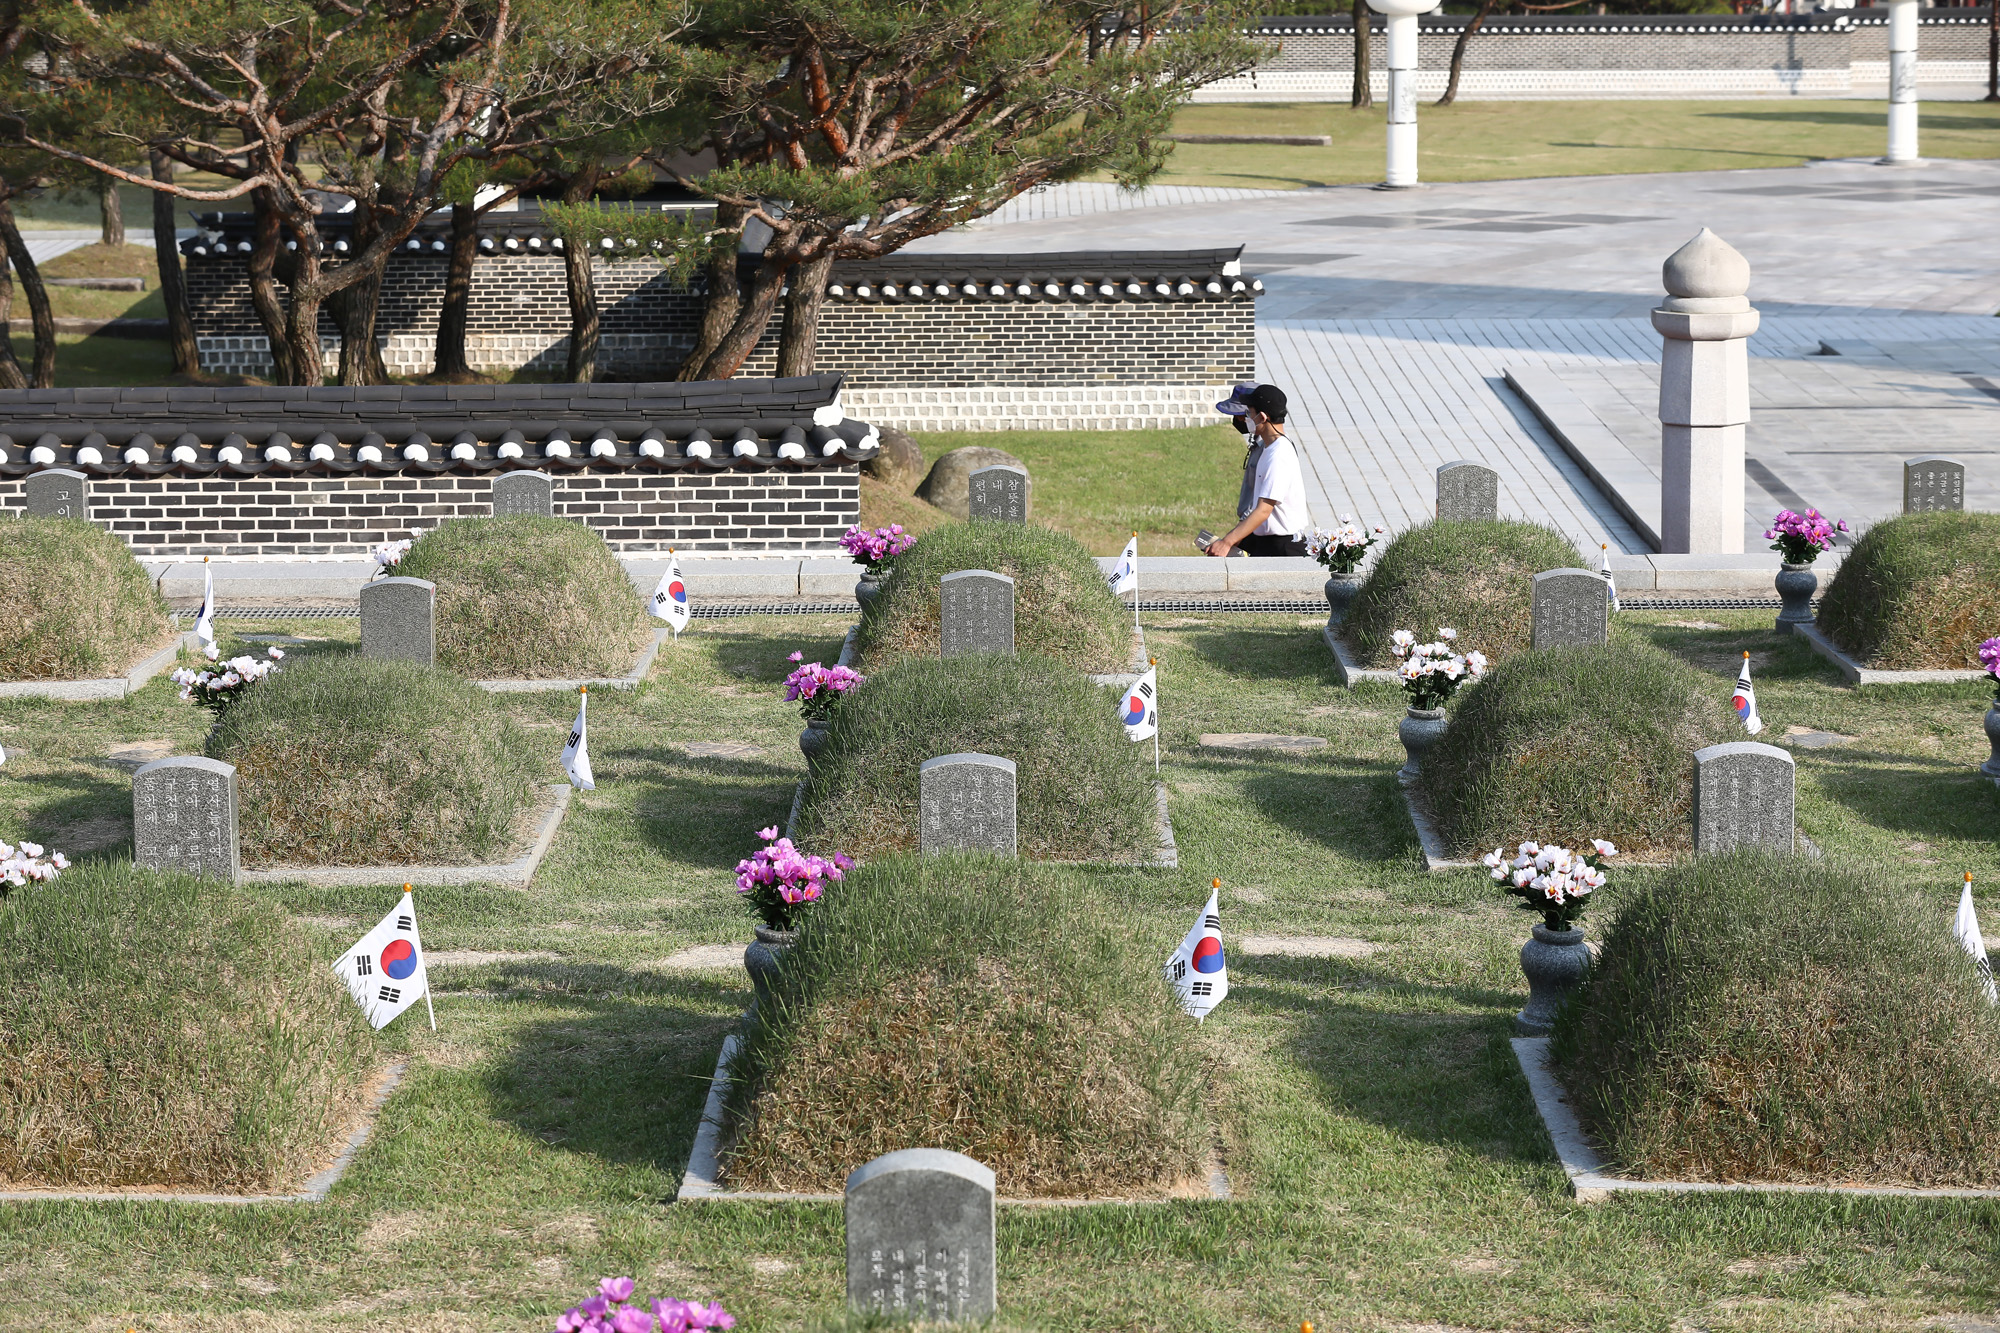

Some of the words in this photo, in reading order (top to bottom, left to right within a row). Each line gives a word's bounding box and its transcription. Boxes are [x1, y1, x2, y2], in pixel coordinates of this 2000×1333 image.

[976, 480, 986, 509] 편히
[992, 480, 1002, 490] 내
[57, 490, 71, 518] 고이
[143, 778, 159, 825] 품안에
[164, 779, 179, 824] 구천의
[991, 773, 1004, 820] 한송이
[206, 777, 222, 858] 열사들이여
[871, 1249, 886, 1278] 모두
[891, 1249, 905, 1264] 내
